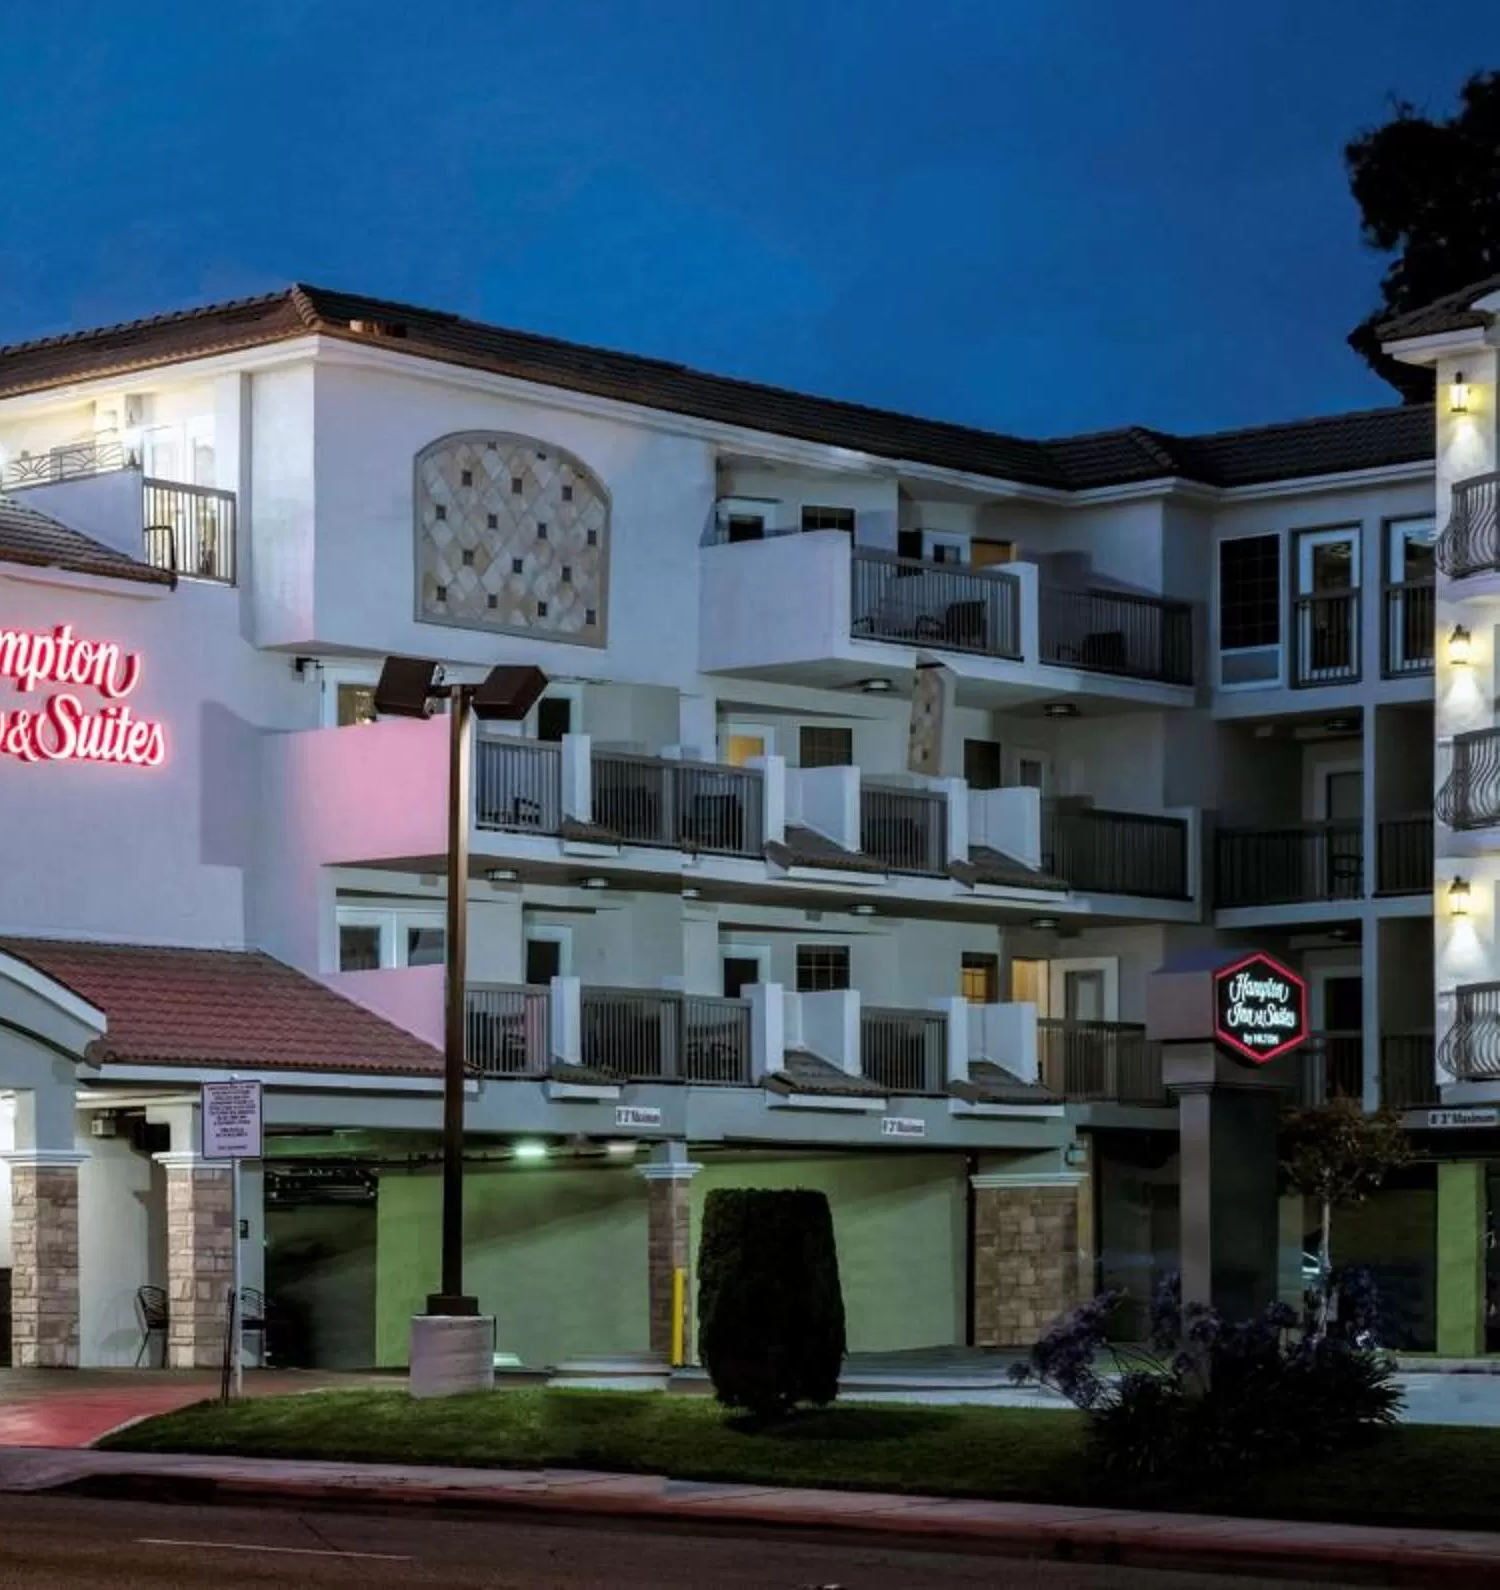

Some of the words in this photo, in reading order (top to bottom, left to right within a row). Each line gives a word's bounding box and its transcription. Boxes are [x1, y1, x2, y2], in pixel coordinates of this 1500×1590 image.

[6, 709, 40, 761] &
[36, 693, 166, 766] Suites
[1229, 972, 1289, 1003] Hampton
[1227, 1002, 1257, 1027] Inn
[1264, 1003, 1296, 1028] Suites
